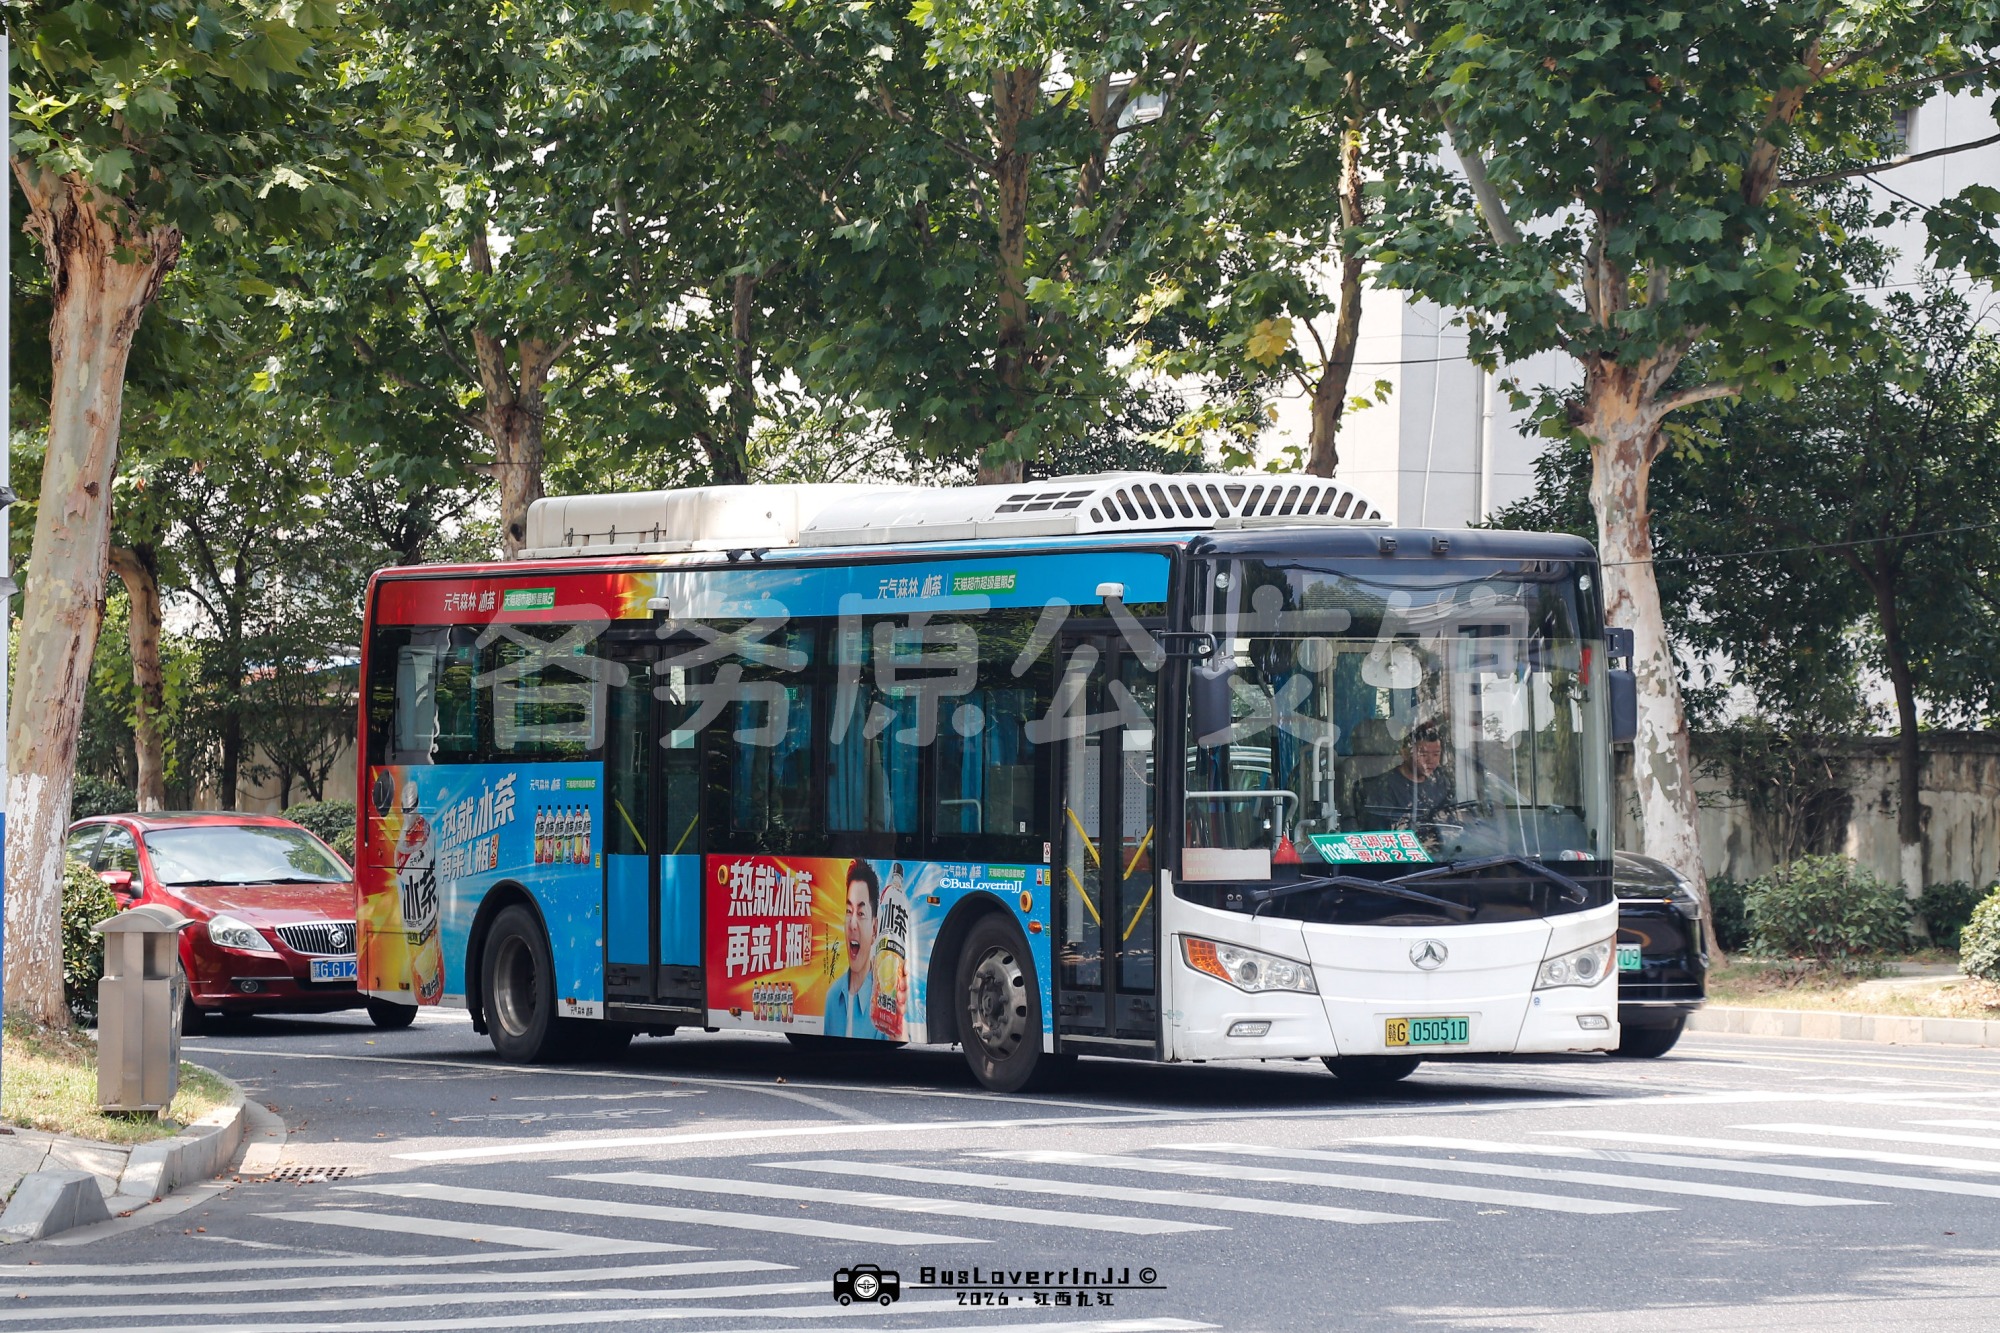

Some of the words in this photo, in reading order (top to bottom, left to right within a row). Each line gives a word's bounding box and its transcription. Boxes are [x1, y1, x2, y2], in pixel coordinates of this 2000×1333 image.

[443, 592, 477, 612] 元气森林
[478, 589, 497, 613] 冰茶
[877, 577, 919, 599] 元气森林
[920, 573, 943, 599] 冰茶
[442, 771, 518, 853] 热就冰茶
[442, 835, 492, 885] 再来1瓶
[1344, 833, 1418, 850] 空调开启
[1354, 849, 1428, 863] 票价2元
[402, 860, 438, 920] 冰茶
[728, 857, 813, 917] 热就冰茶
[879, 897, 909, 943] 冰茶
[726, 920, 804, 978] 再来1瓶
